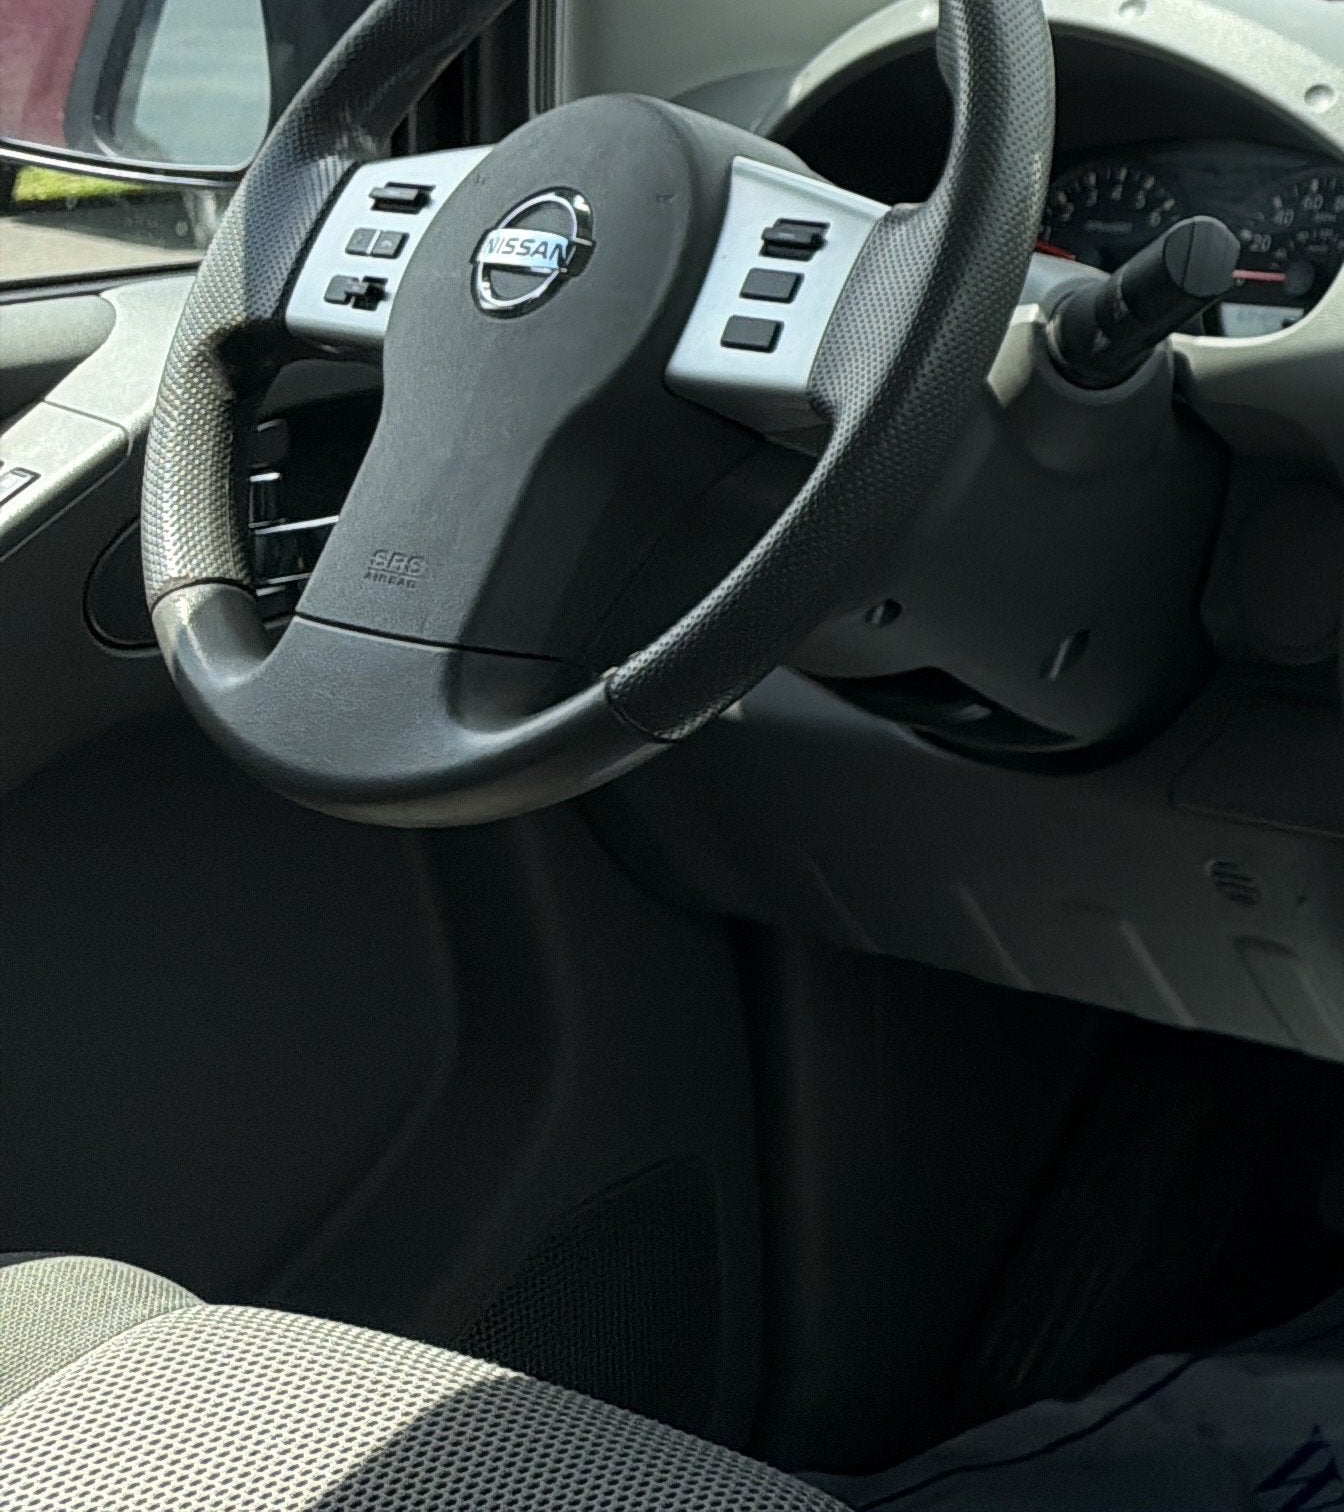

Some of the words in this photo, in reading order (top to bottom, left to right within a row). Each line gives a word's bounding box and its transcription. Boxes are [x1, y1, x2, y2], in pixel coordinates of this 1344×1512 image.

[485, 234, 572, 274] NISSAN
[1250, 233, 1272, 252] 20
[369, 549, 425, 576] SRS
